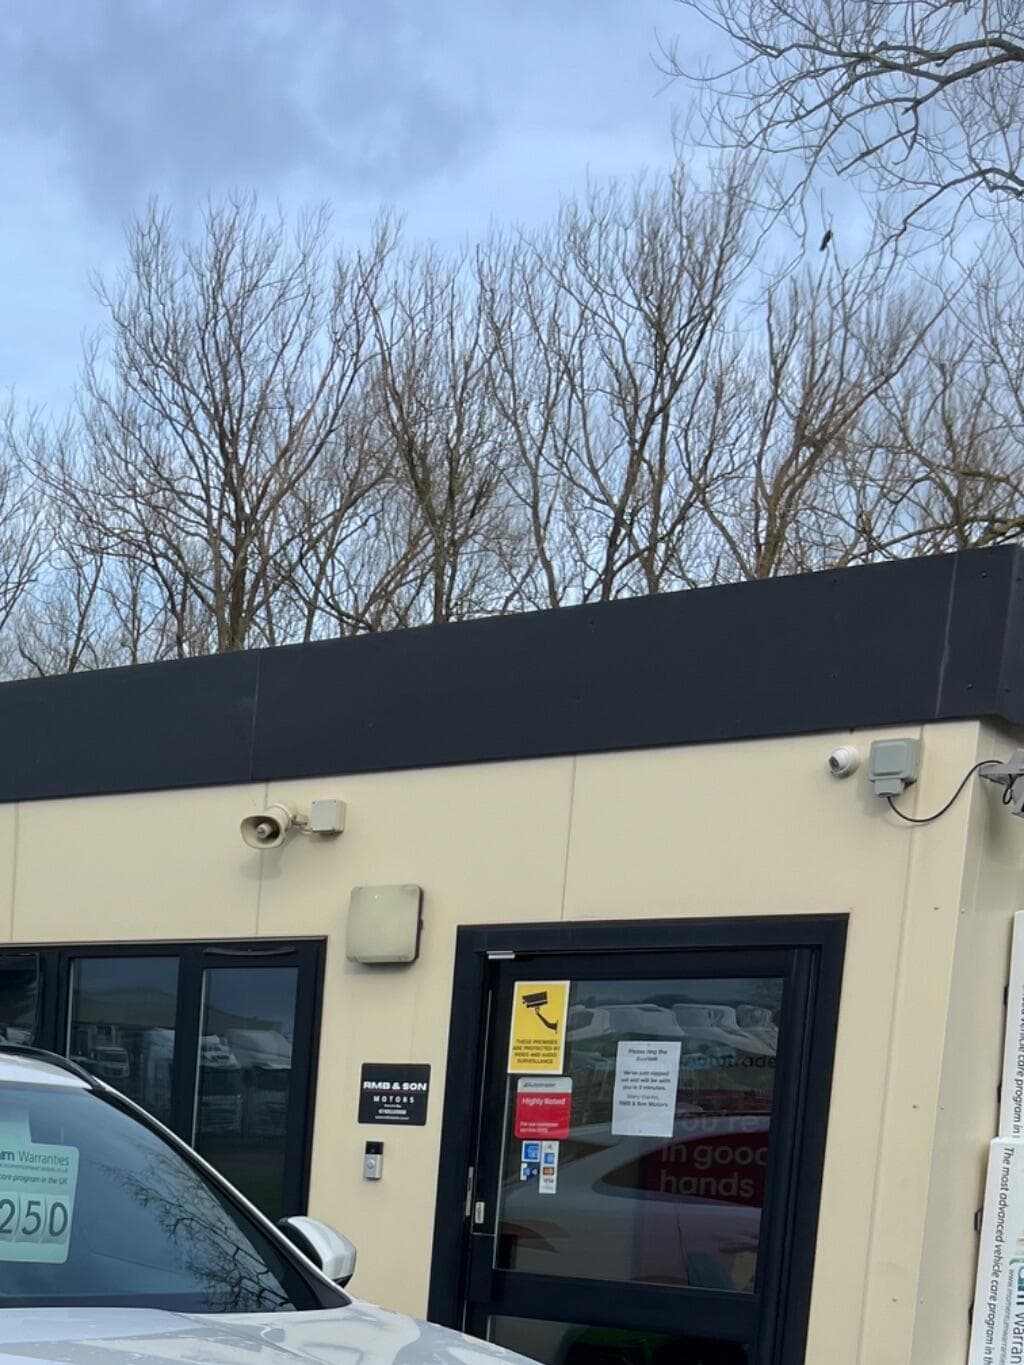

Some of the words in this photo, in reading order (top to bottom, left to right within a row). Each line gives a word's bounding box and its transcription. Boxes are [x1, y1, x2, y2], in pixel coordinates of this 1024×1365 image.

[363, 1081, 391, 1090] RMB
[391, 1081, 401, 1090] &
[402, 1082, 428, 1091] SON
[373, 1095, 415, 1104] MOTORS
[522, 1096, 544, 1107] Highly
[544, 1096, 566, 1105] Rated
[1012, 1078, 1024, 1123] program
[675, 1108, 761, 1133] ou're
[19, 1150, 70, 1166] Warranties
[661, 1140, 687, 1162] in
[1002, 1148, 1015, 1166] The
[13, 1174, 41, 1184] program
[660, 1168, 755, 1198] hands
[1000, 1166, 1010, 1192] most
[995, 1192, 1008, 1244] advanced
[991, 1244, 1005, 1279] vehicle
[989, 1279, 999, 1302] care
[984, 1301, 996, 1346] program
[984, 1346, 995, 1356] in
